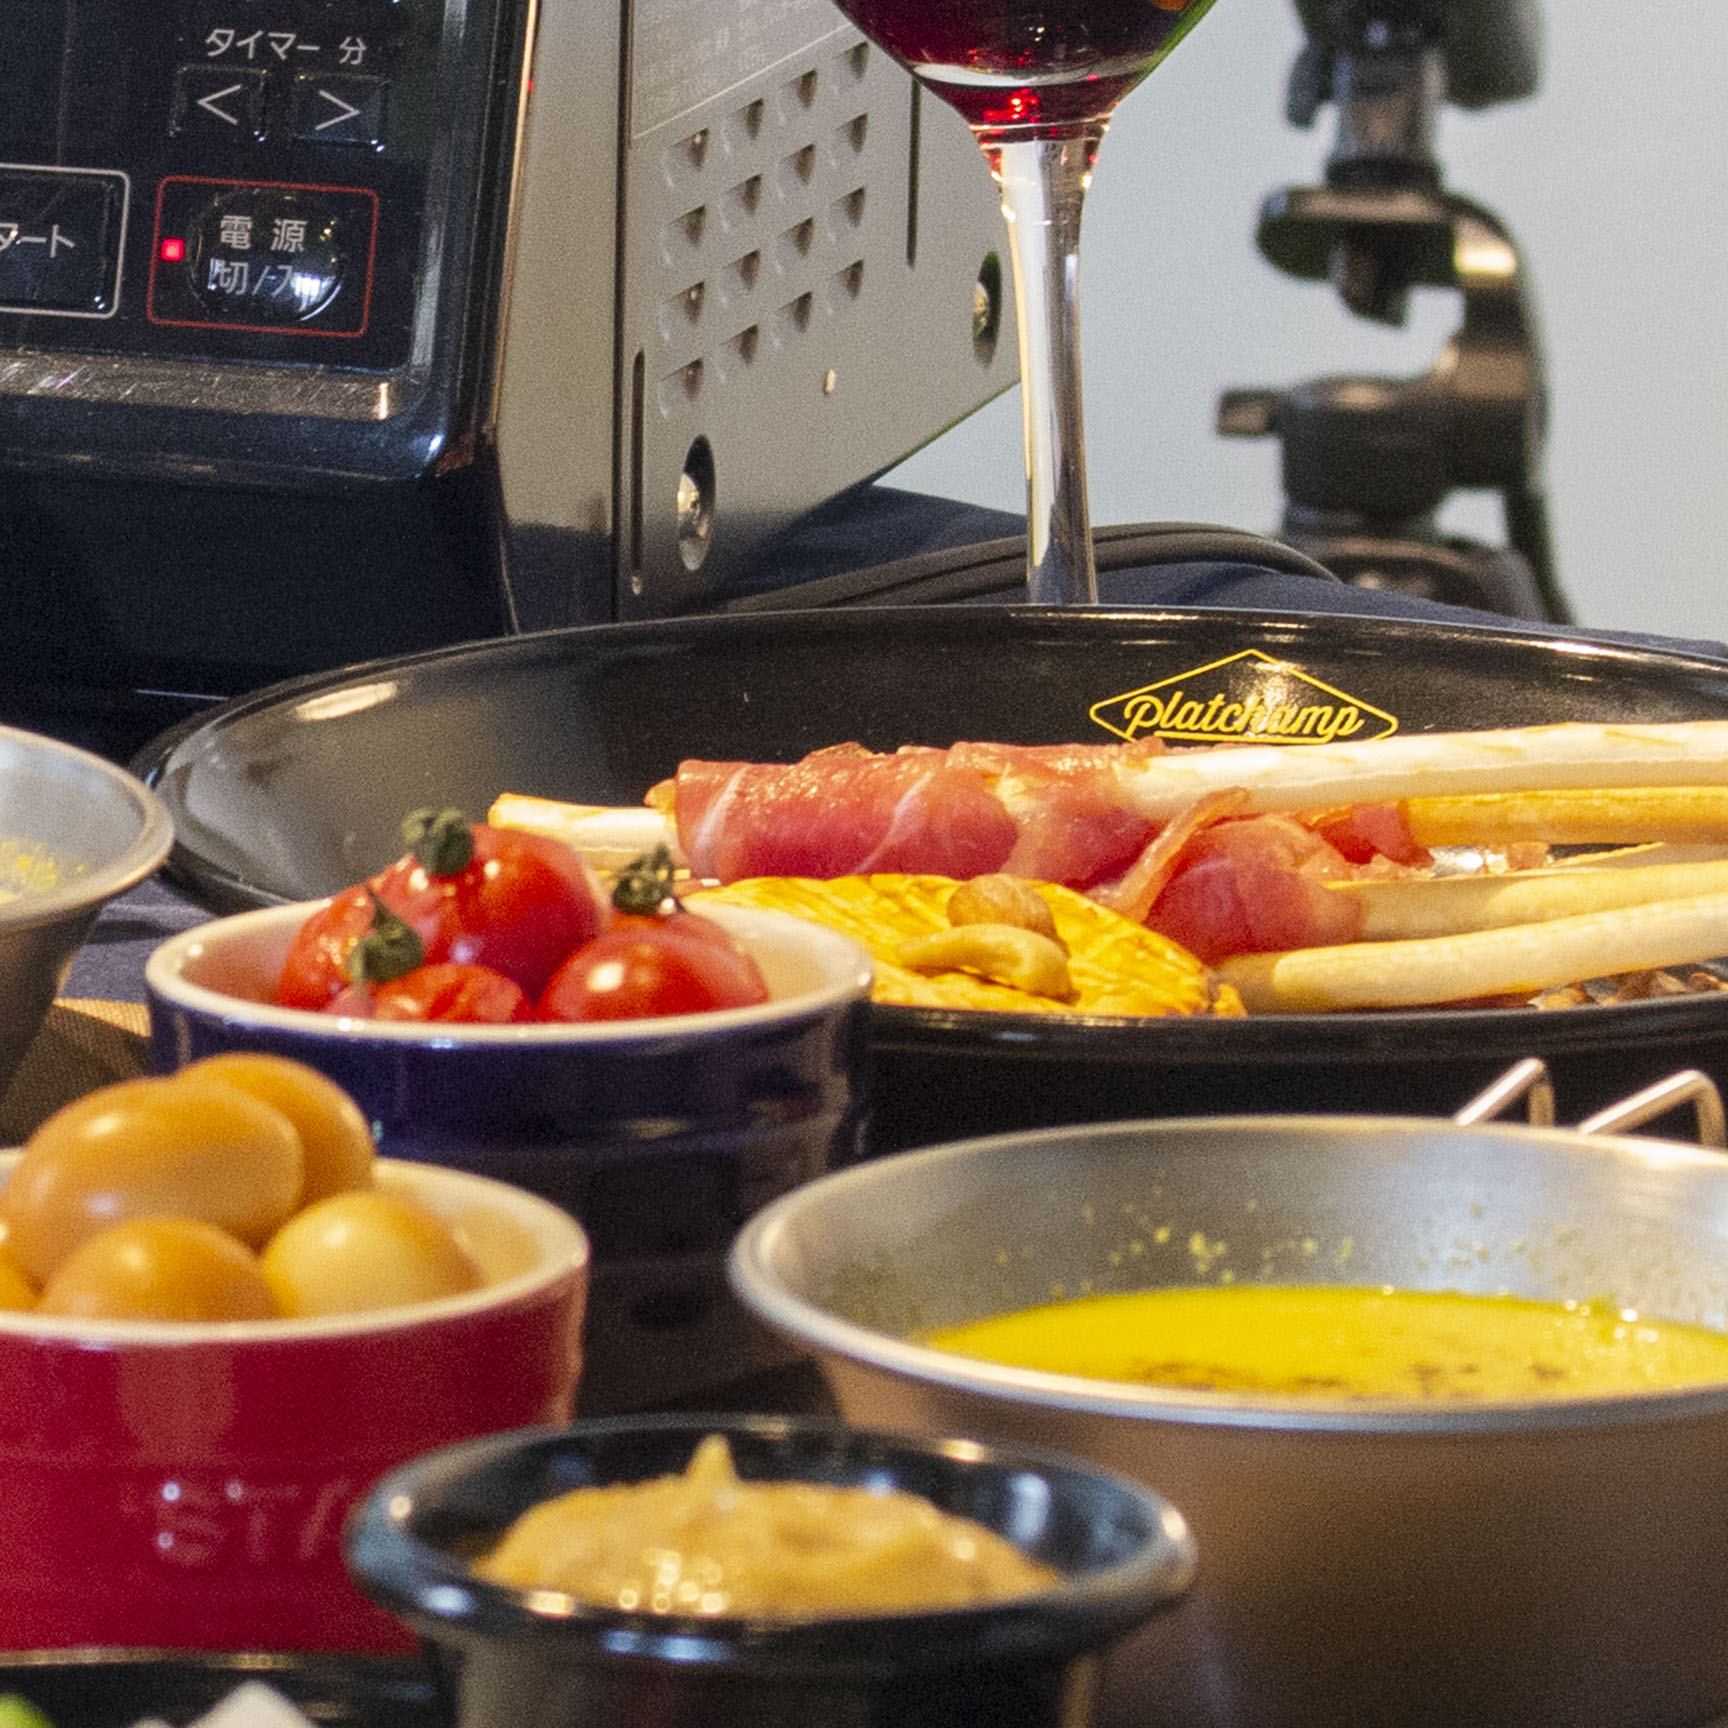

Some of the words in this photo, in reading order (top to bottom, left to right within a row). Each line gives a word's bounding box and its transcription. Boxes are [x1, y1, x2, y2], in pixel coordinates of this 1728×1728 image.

[204, 28, 321, 61] タイマー
[1123, 690, 1365, 745] Platchamp
